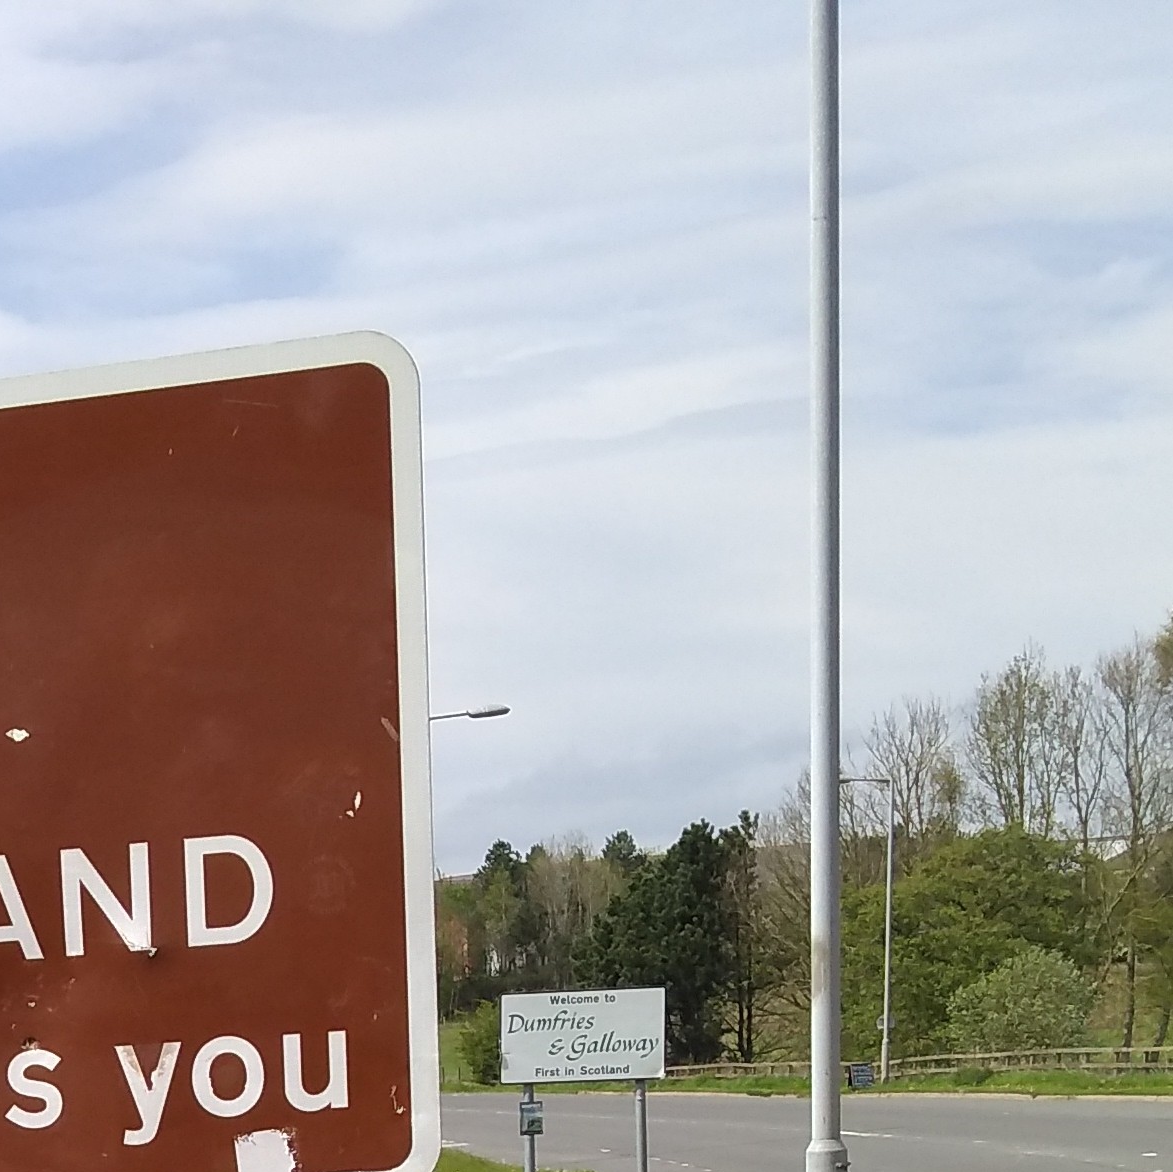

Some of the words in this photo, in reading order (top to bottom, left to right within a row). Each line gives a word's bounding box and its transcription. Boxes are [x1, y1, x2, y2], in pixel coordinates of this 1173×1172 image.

[550, 995, 600, 1005] Welcome
[604, 993, 616, 1003] to
[507, 1010, 595, 1034] Dumfries
[548, 1038, 565, 1056] &
[565, 1031, 659, 1061] Galloway
[535, 1067, 560, 1077] First
[564, 1065, 575, 1076] in
[580, 1064, 630, 1075] Scotland
[114, 1030, 349, 1146] you
